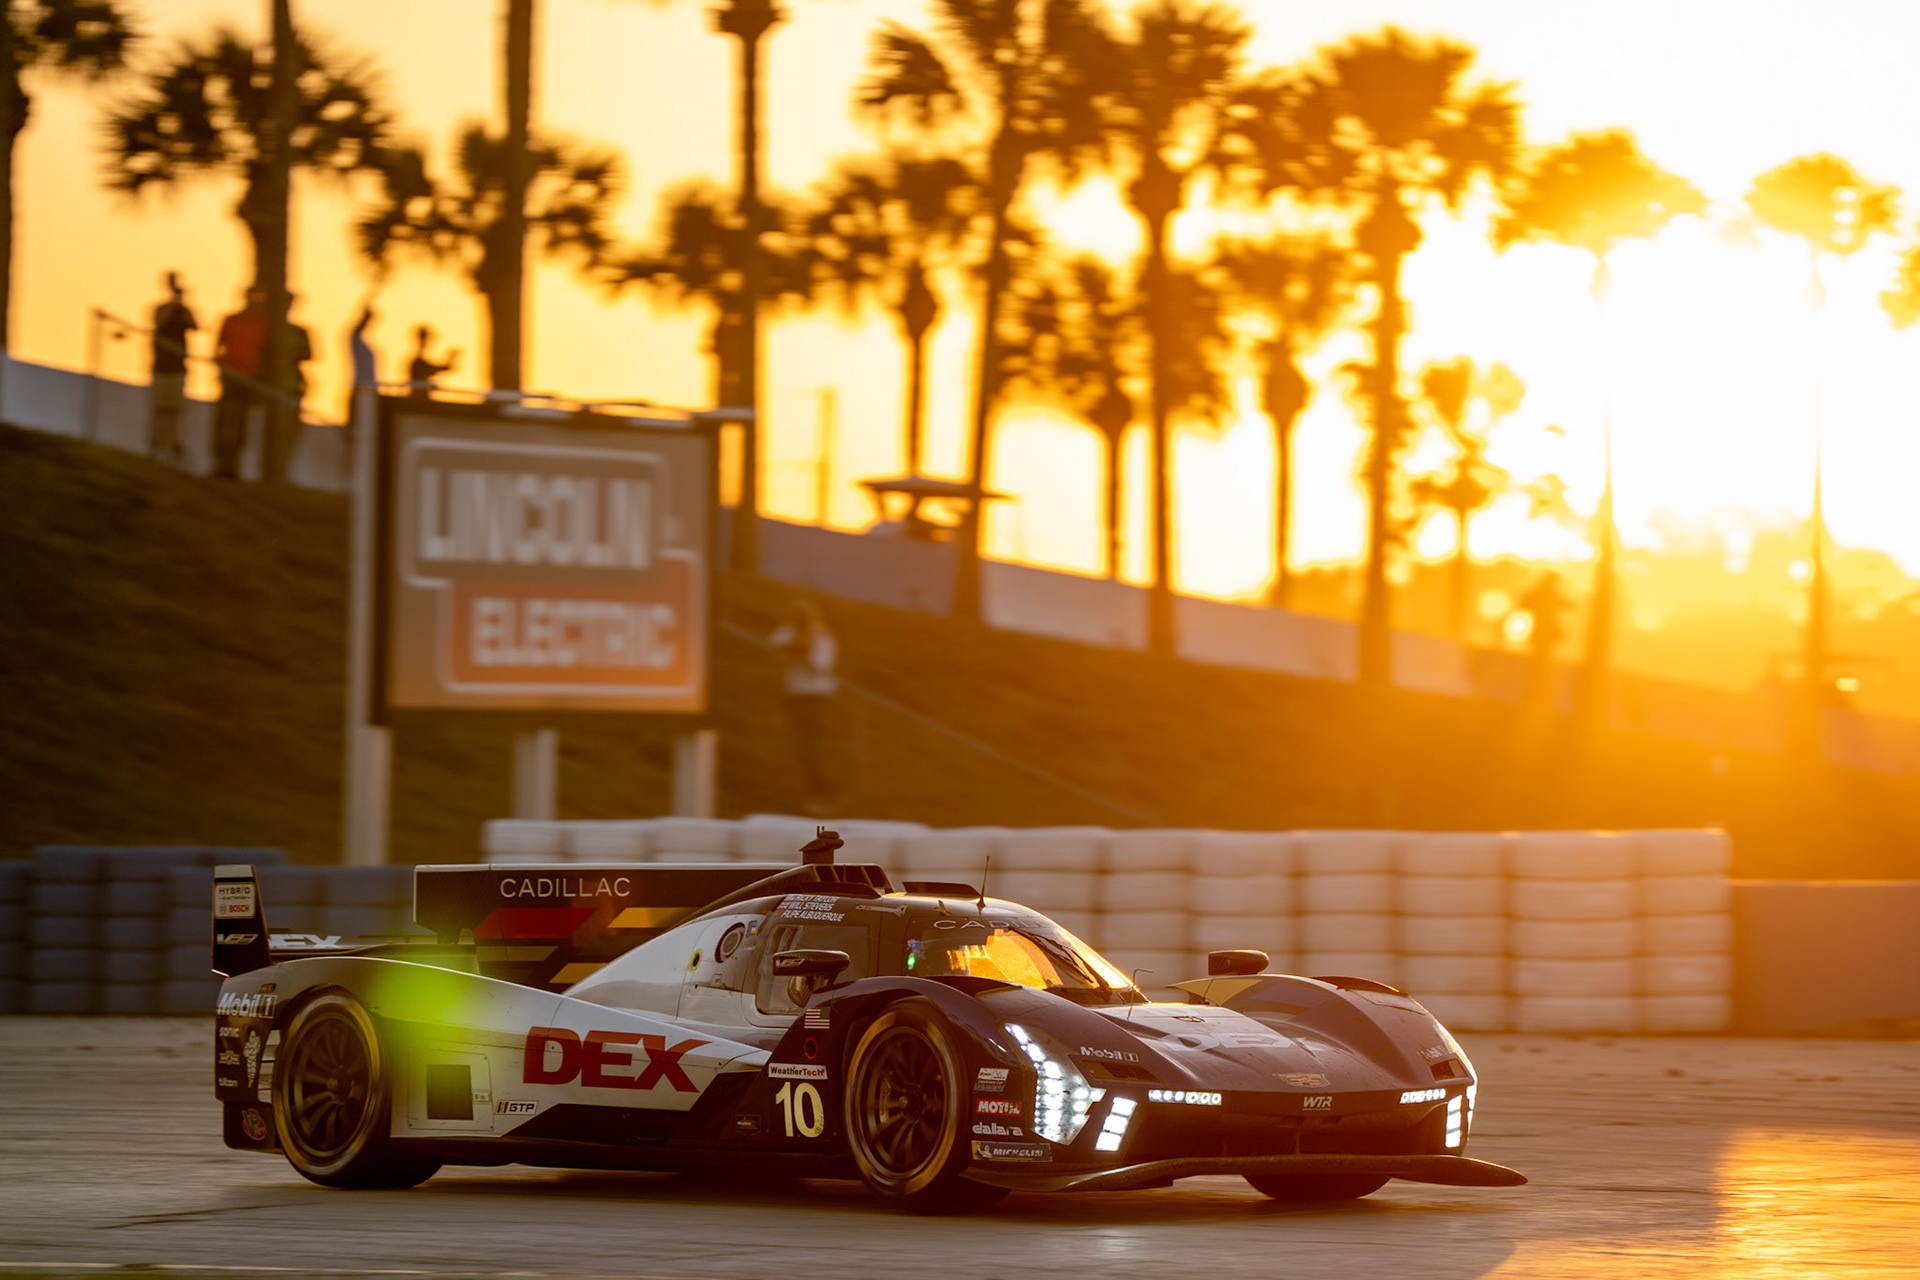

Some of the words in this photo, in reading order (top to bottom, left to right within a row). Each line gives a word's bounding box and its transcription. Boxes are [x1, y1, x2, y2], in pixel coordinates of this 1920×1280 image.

[418, 467, 651, 569] LINCOLN
[471, 596, 675, 671] ELECTRIC
[218, 886, 251, 895] HYBRID
[500, 877, 631, 898] CADILLAC
[229, 904, 250, 913] BOSCH
[268, 933, 342, 949] EX
[217, 992, 261, 1018] Mobil
[523, 1026, 712, 1093] DEX
[1080, 1046, 1123, 1060] Mobil
[770, 1066, 825, 1077] WeatherTech
[508, 1103, 535, 1112] GTP
[1303, 1095, 1333, 1108] WTR
[775, 1081, 825, 1138] 10
[972, 1122, 1023, 1136] dallara
[993, 1147, 1043, 1157] MICHELIN
